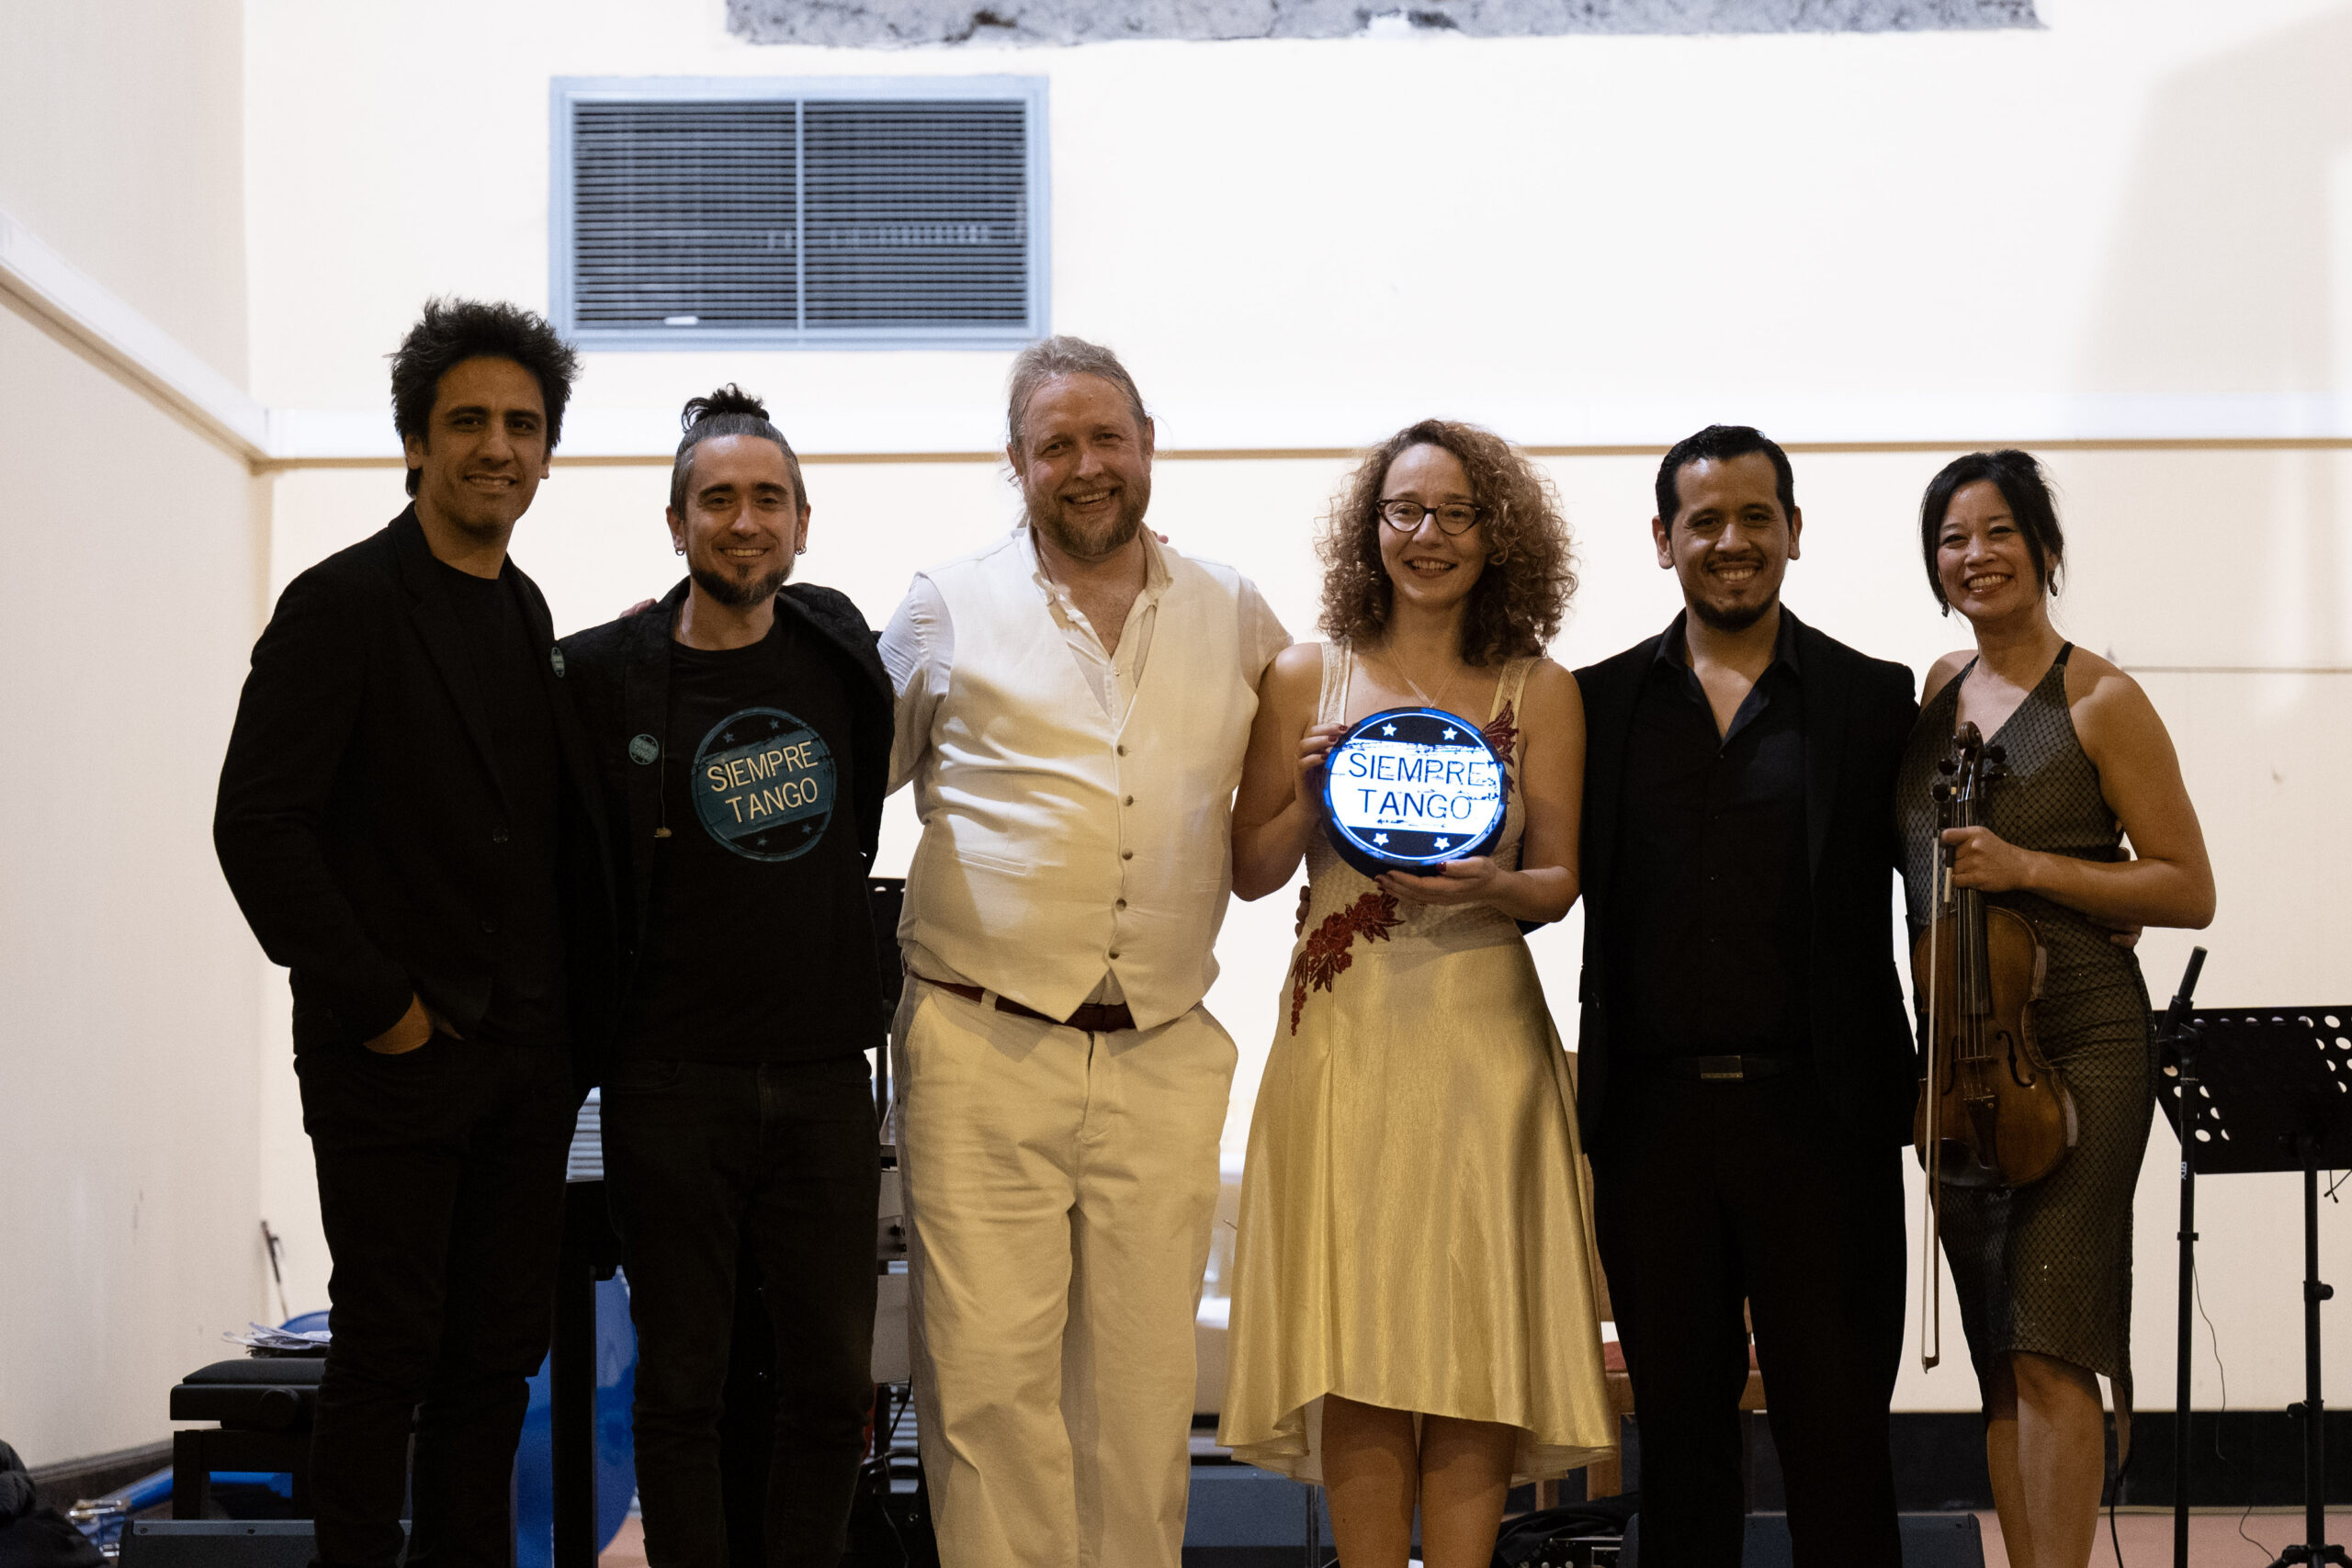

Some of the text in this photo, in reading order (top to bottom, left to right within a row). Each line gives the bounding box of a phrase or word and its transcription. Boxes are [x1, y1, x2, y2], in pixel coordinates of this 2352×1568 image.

[707, 740, 819, 792] SIEMPRE
[1348, 752, 1486, 786] SIEMPRE
[725, 777, 819, 823] TANGO
[1357, 788, 1472, 819] TANGO
